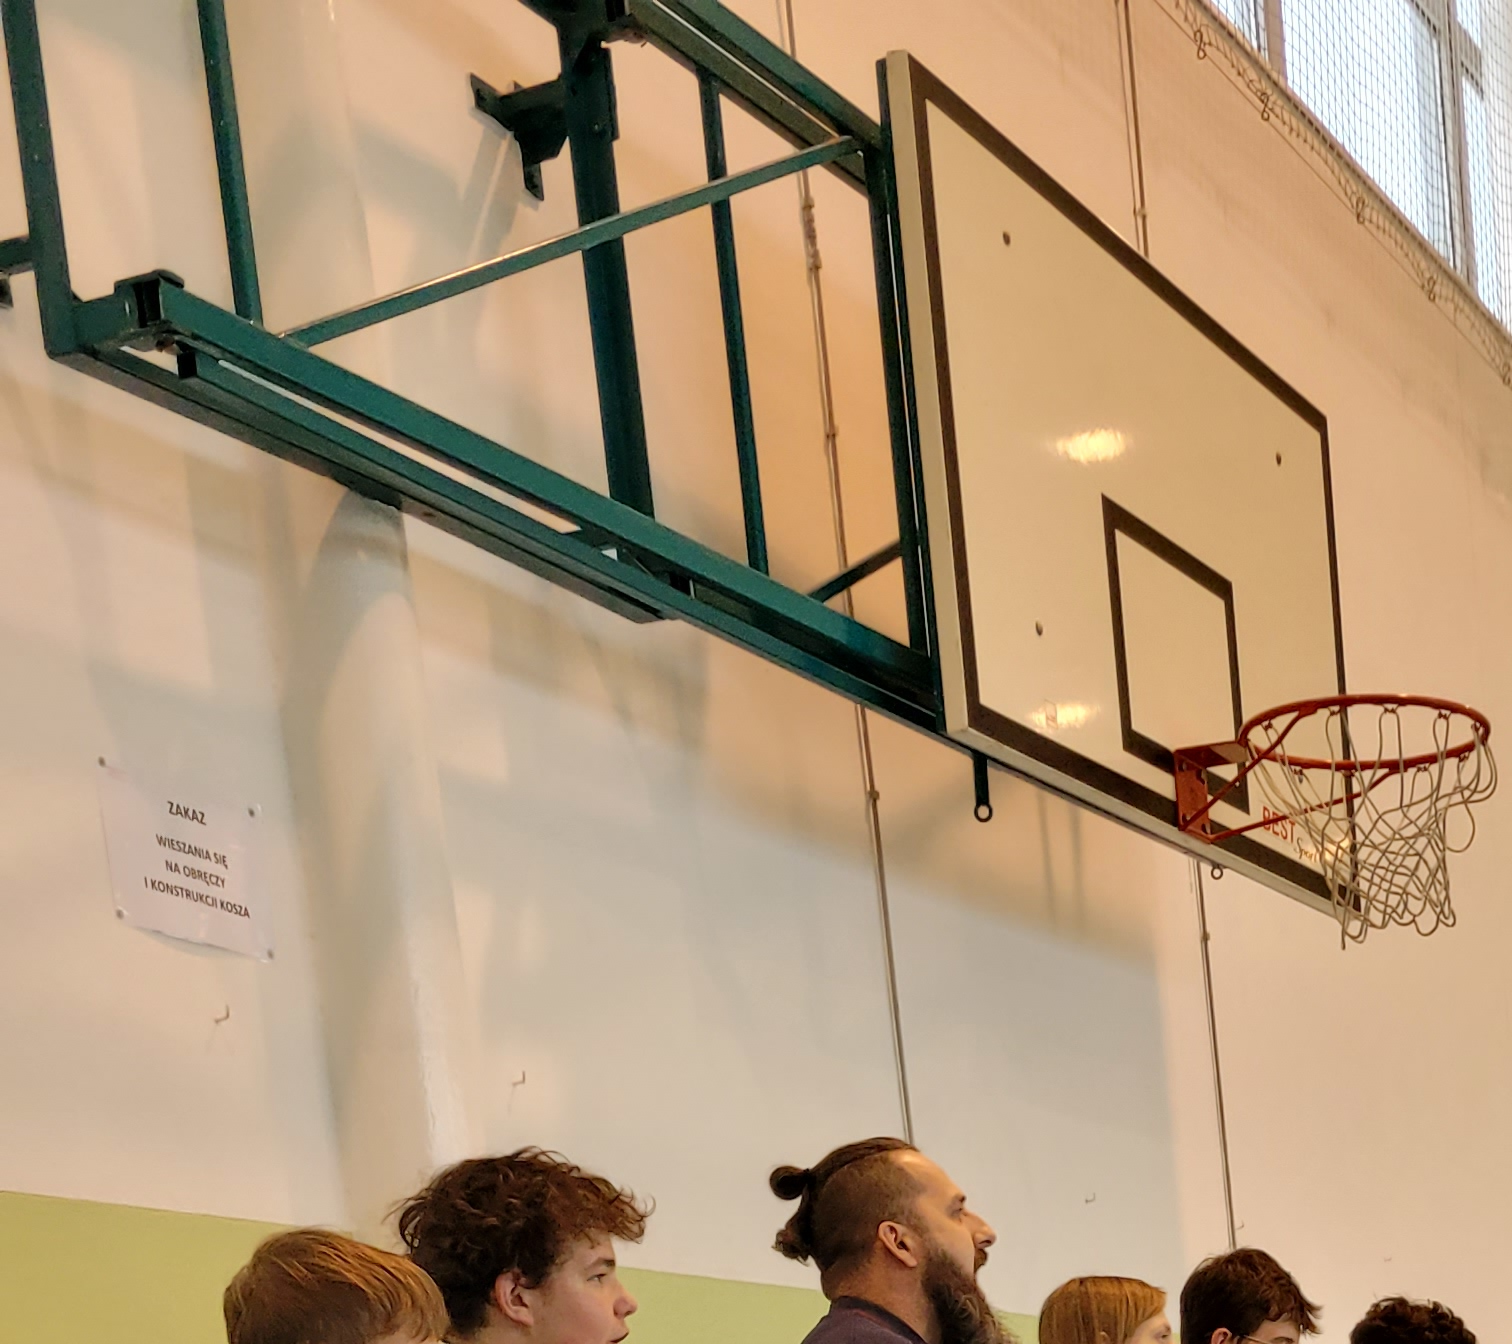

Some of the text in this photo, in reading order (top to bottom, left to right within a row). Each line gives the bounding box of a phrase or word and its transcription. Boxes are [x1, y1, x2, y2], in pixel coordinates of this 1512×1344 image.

[167, 800, 207, 826] ZAKAZ
[155, 833, 229, 870] WIESZANIA SIĘ
[165, 859, 226, 889] NA OBRĘCZY
[144, 876, 251, 919] I KONSTRUKCJI KOSZA
